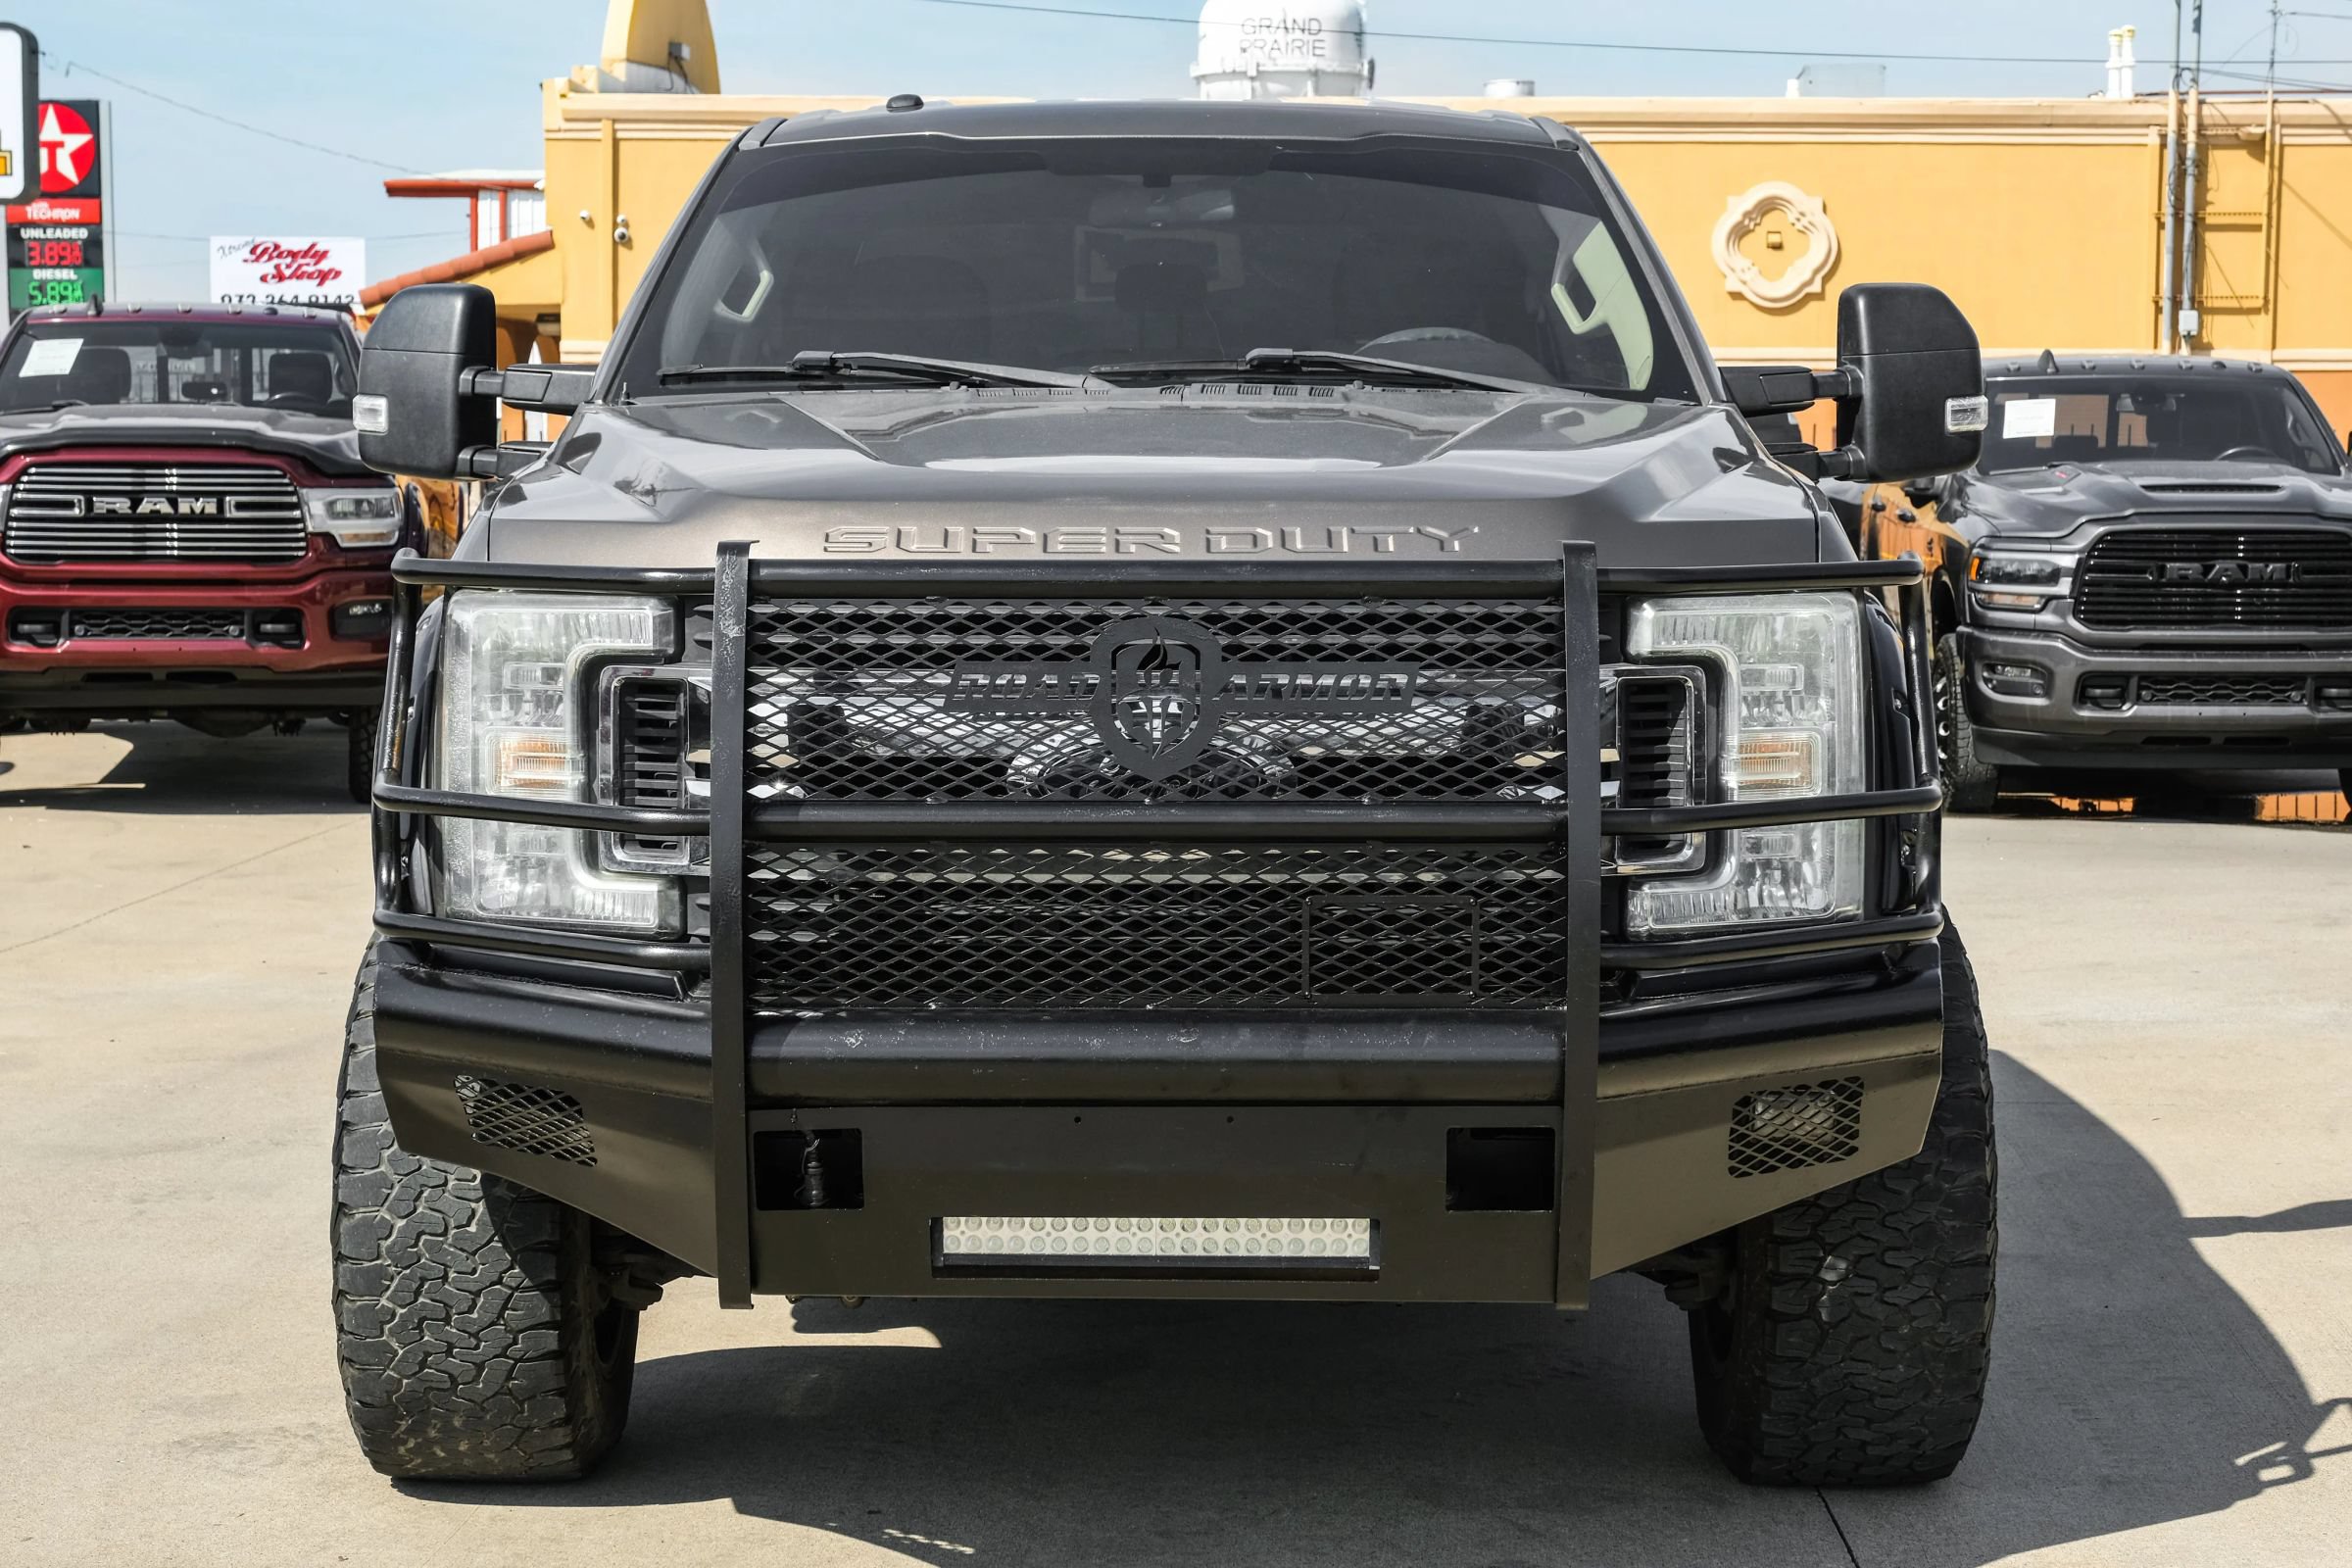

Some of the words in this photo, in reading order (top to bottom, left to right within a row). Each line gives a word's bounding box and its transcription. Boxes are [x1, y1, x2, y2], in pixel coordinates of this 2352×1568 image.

[1241, 18, 1322, 35] GRAND
[1240, 39, 1326, 57] PRAIRIE
[20, 227, 88, 239] UNLEADED
[242, 241, 329, 266] Body
[32, 269, 77, 280] DIESEL
[260, 263, 342, 287] Shop
[92, 497, 218, 514] RAM
[823, 526, 1182, 554] SUPER
[1205, 526, 1479, 554] DUTY
[2165, 561, 2287, 581] RAM
[953, 672, 1101, 701] ROAD
[1212, 672, 1409, 701] ARMOR
